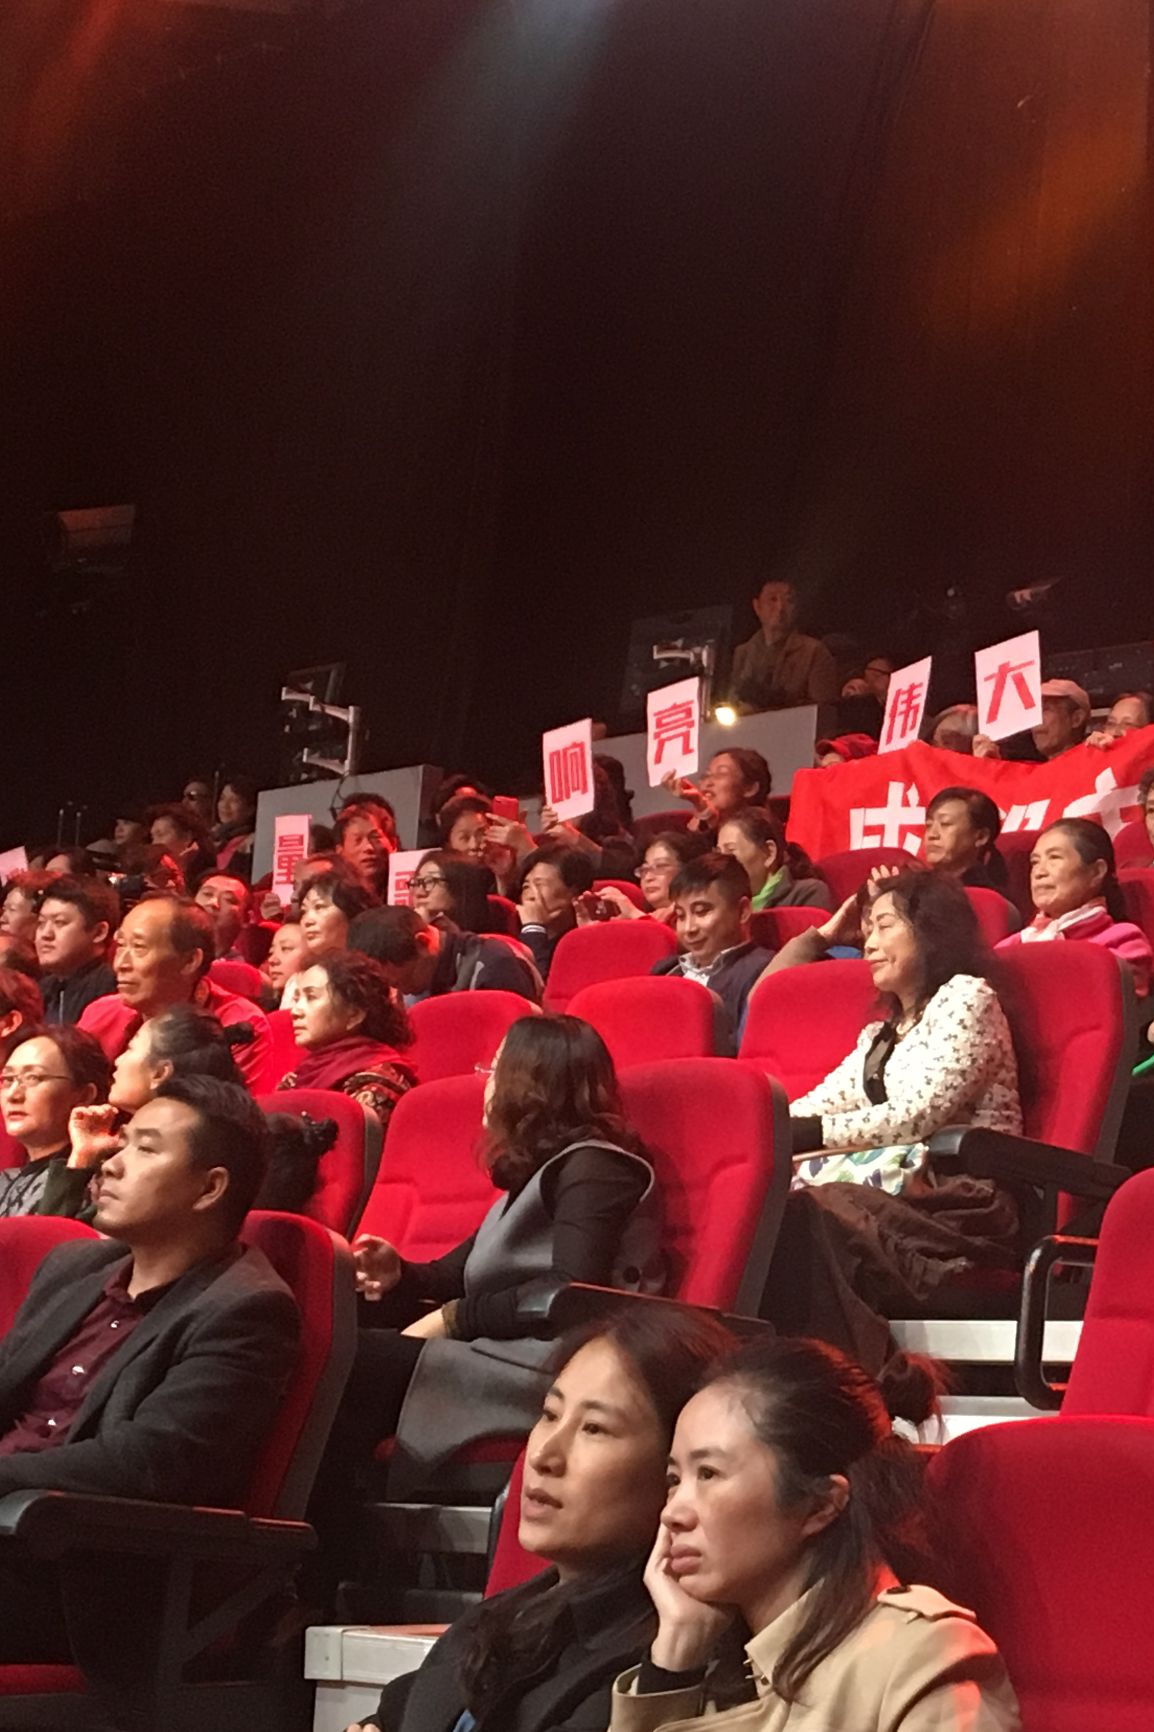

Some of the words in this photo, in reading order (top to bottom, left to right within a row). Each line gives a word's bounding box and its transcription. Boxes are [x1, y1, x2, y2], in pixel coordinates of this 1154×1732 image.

[885, 682, 925, 746] 伟
[984, 658, 1037, 725] 大
[653, 700, 695, 765] 亮
[549, 740, 589, 804] 响
